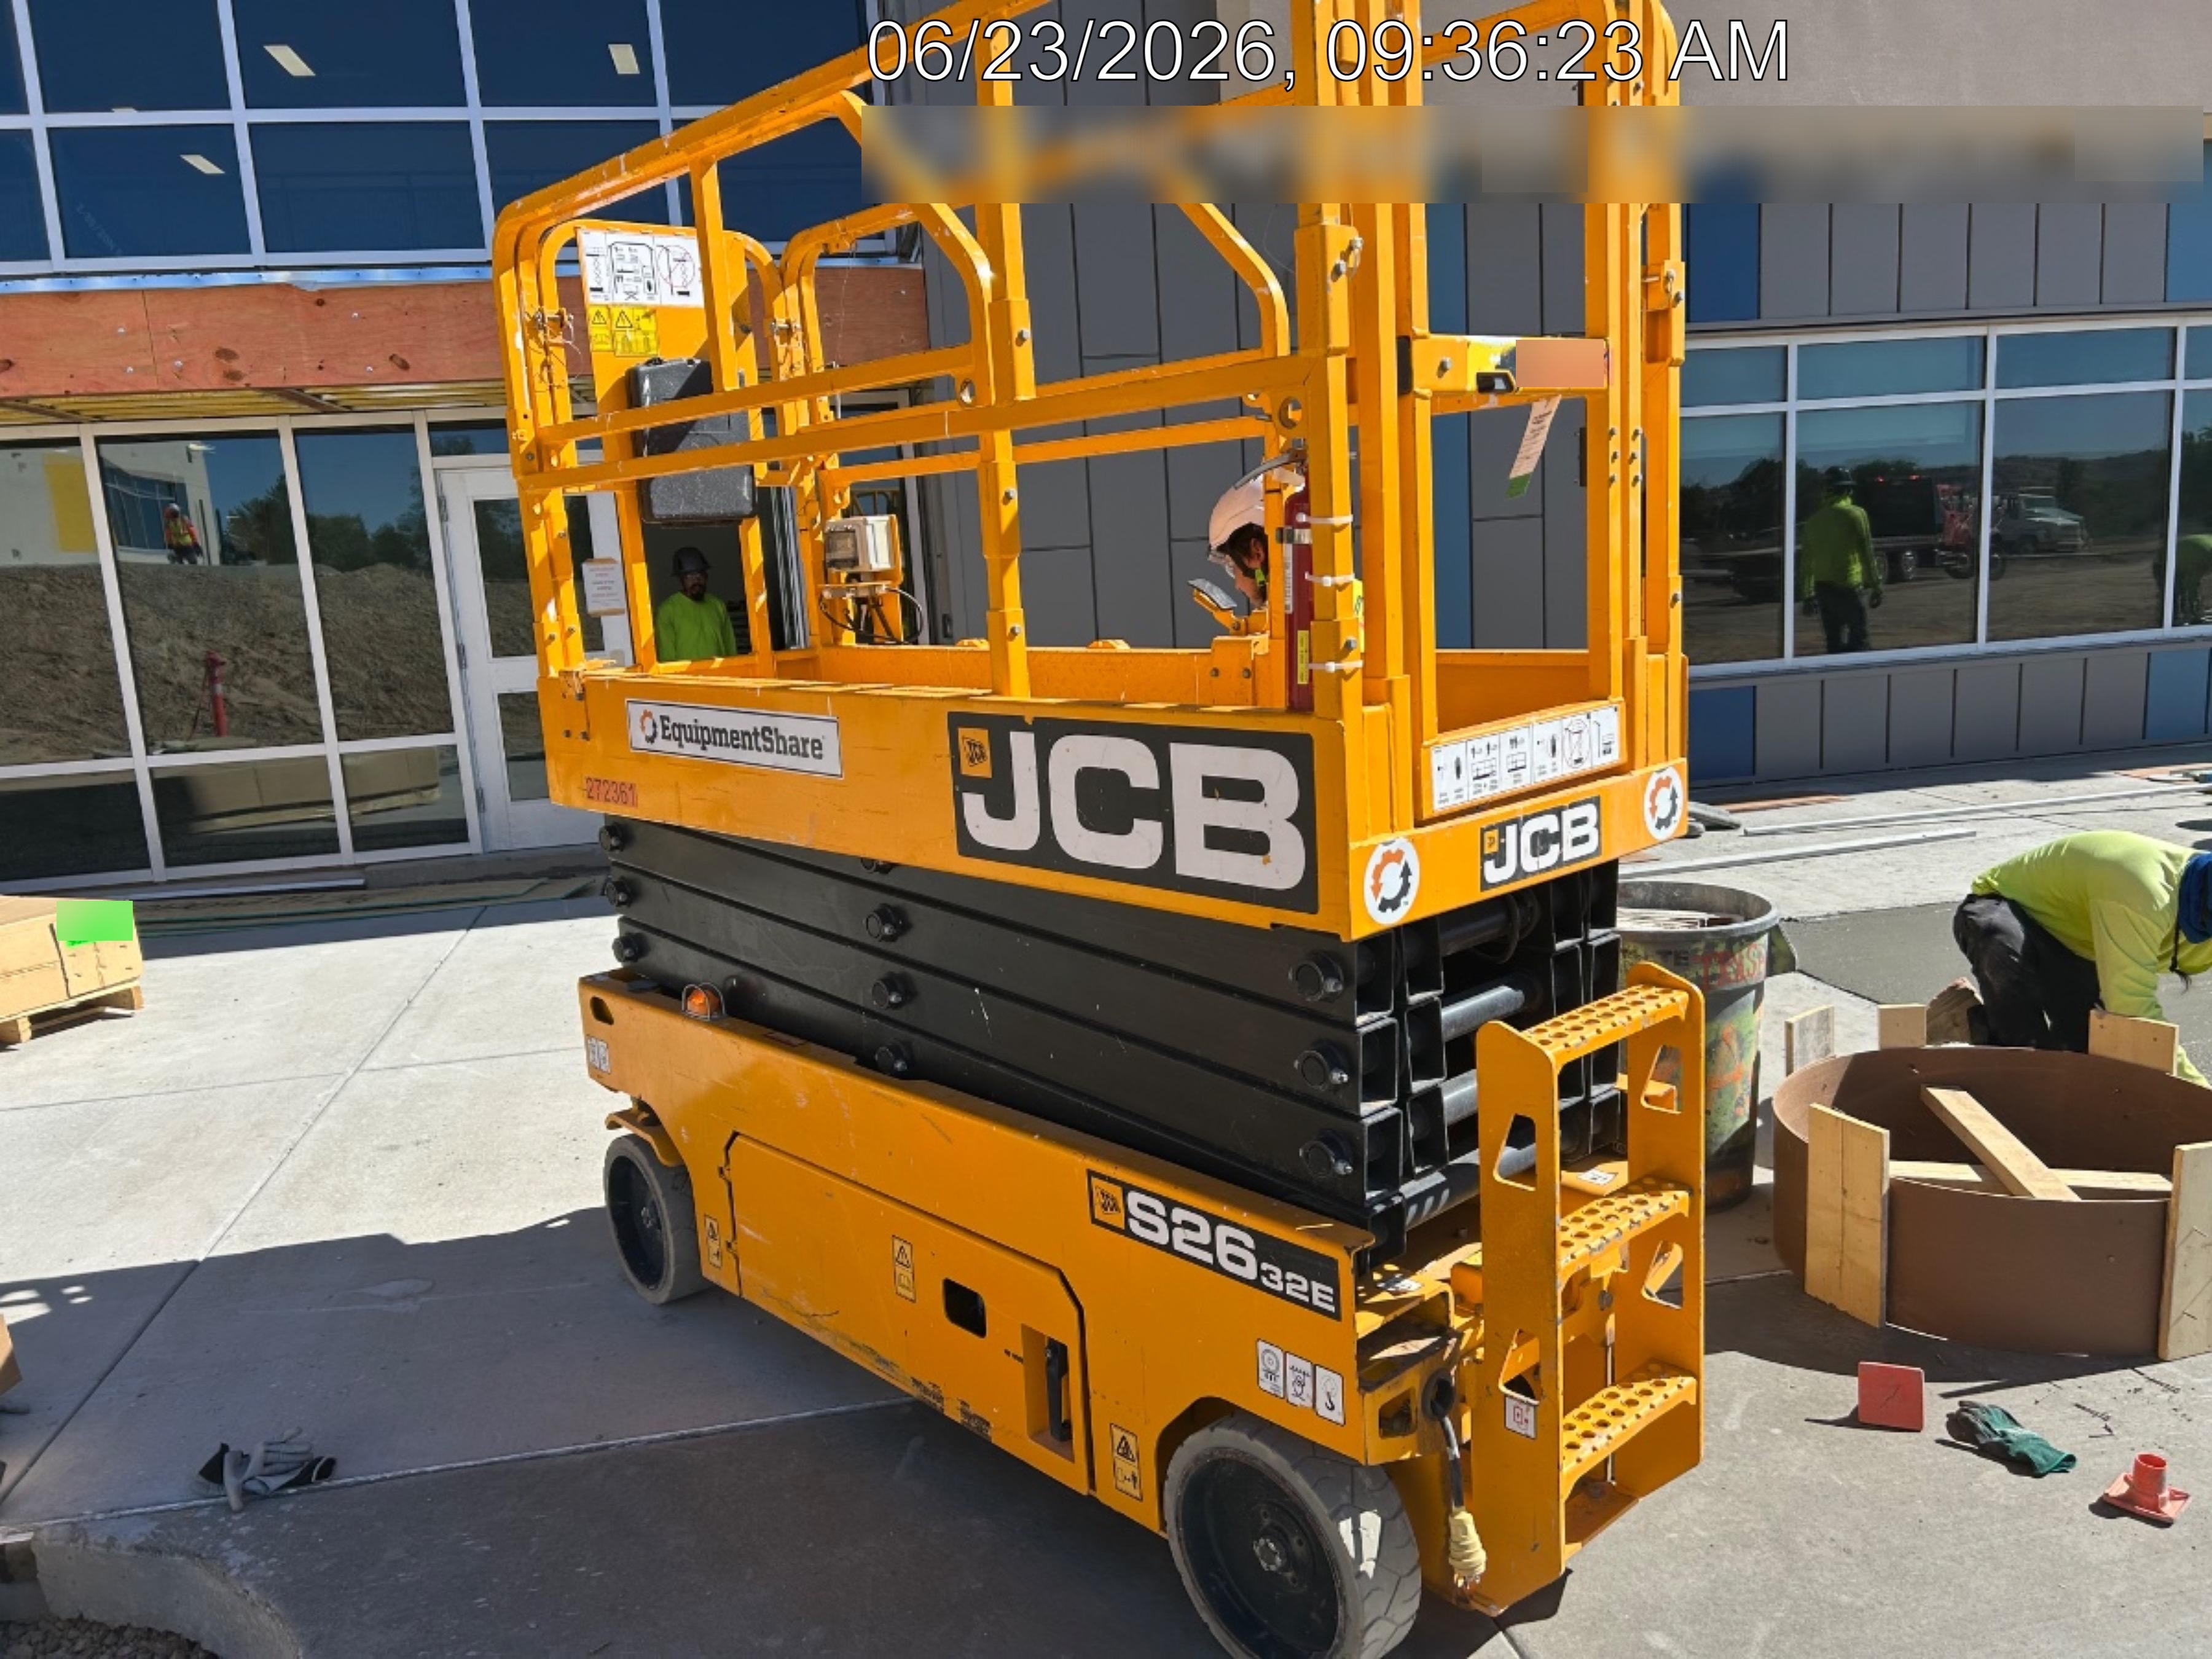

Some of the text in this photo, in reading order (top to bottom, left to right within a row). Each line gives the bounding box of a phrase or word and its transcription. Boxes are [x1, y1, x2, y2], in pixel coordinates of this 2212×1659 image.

[659, 715, 823, 759] EquipmentShare
[961, 730, 1306, 890] JCB
[1484, 803, 1599, 884] JCB
